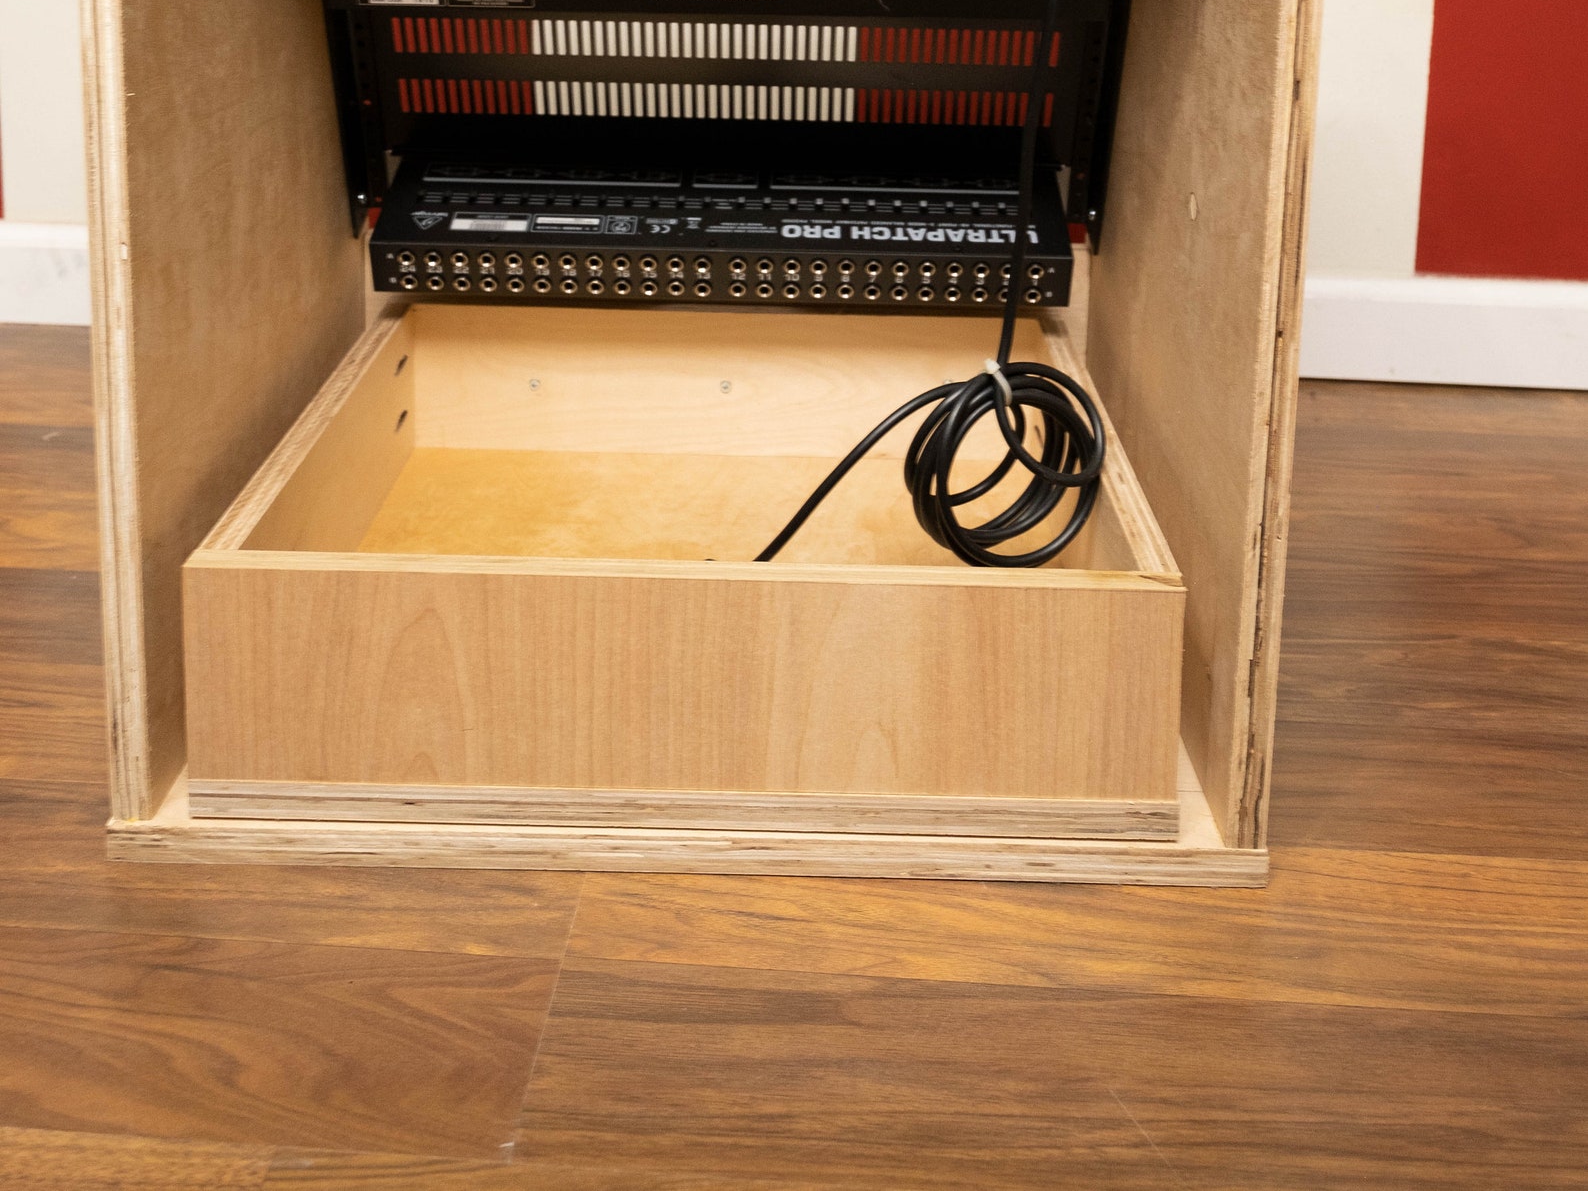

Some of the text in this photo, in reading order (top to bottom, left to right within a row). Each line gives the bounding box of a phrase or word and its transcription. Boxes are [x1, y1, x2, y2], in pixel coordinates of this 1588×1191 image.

[781, 225, 841, 239] PRO
[400, 265, 417, 273] 24
[426, 265, 443, 273] 23
[453, 266, 469, 274] 22
[480, 266, 496, 274] 21
[506, 267, 523, 275] 20
[588, 269, 603, 277] 17
[641, 270, 657, 278] 15
[668, 271, 684, 279] 14
[696, 271, 711, 279] 13
[731, 272, 746, 280] 12
[784, 273, 800, 281] 10
